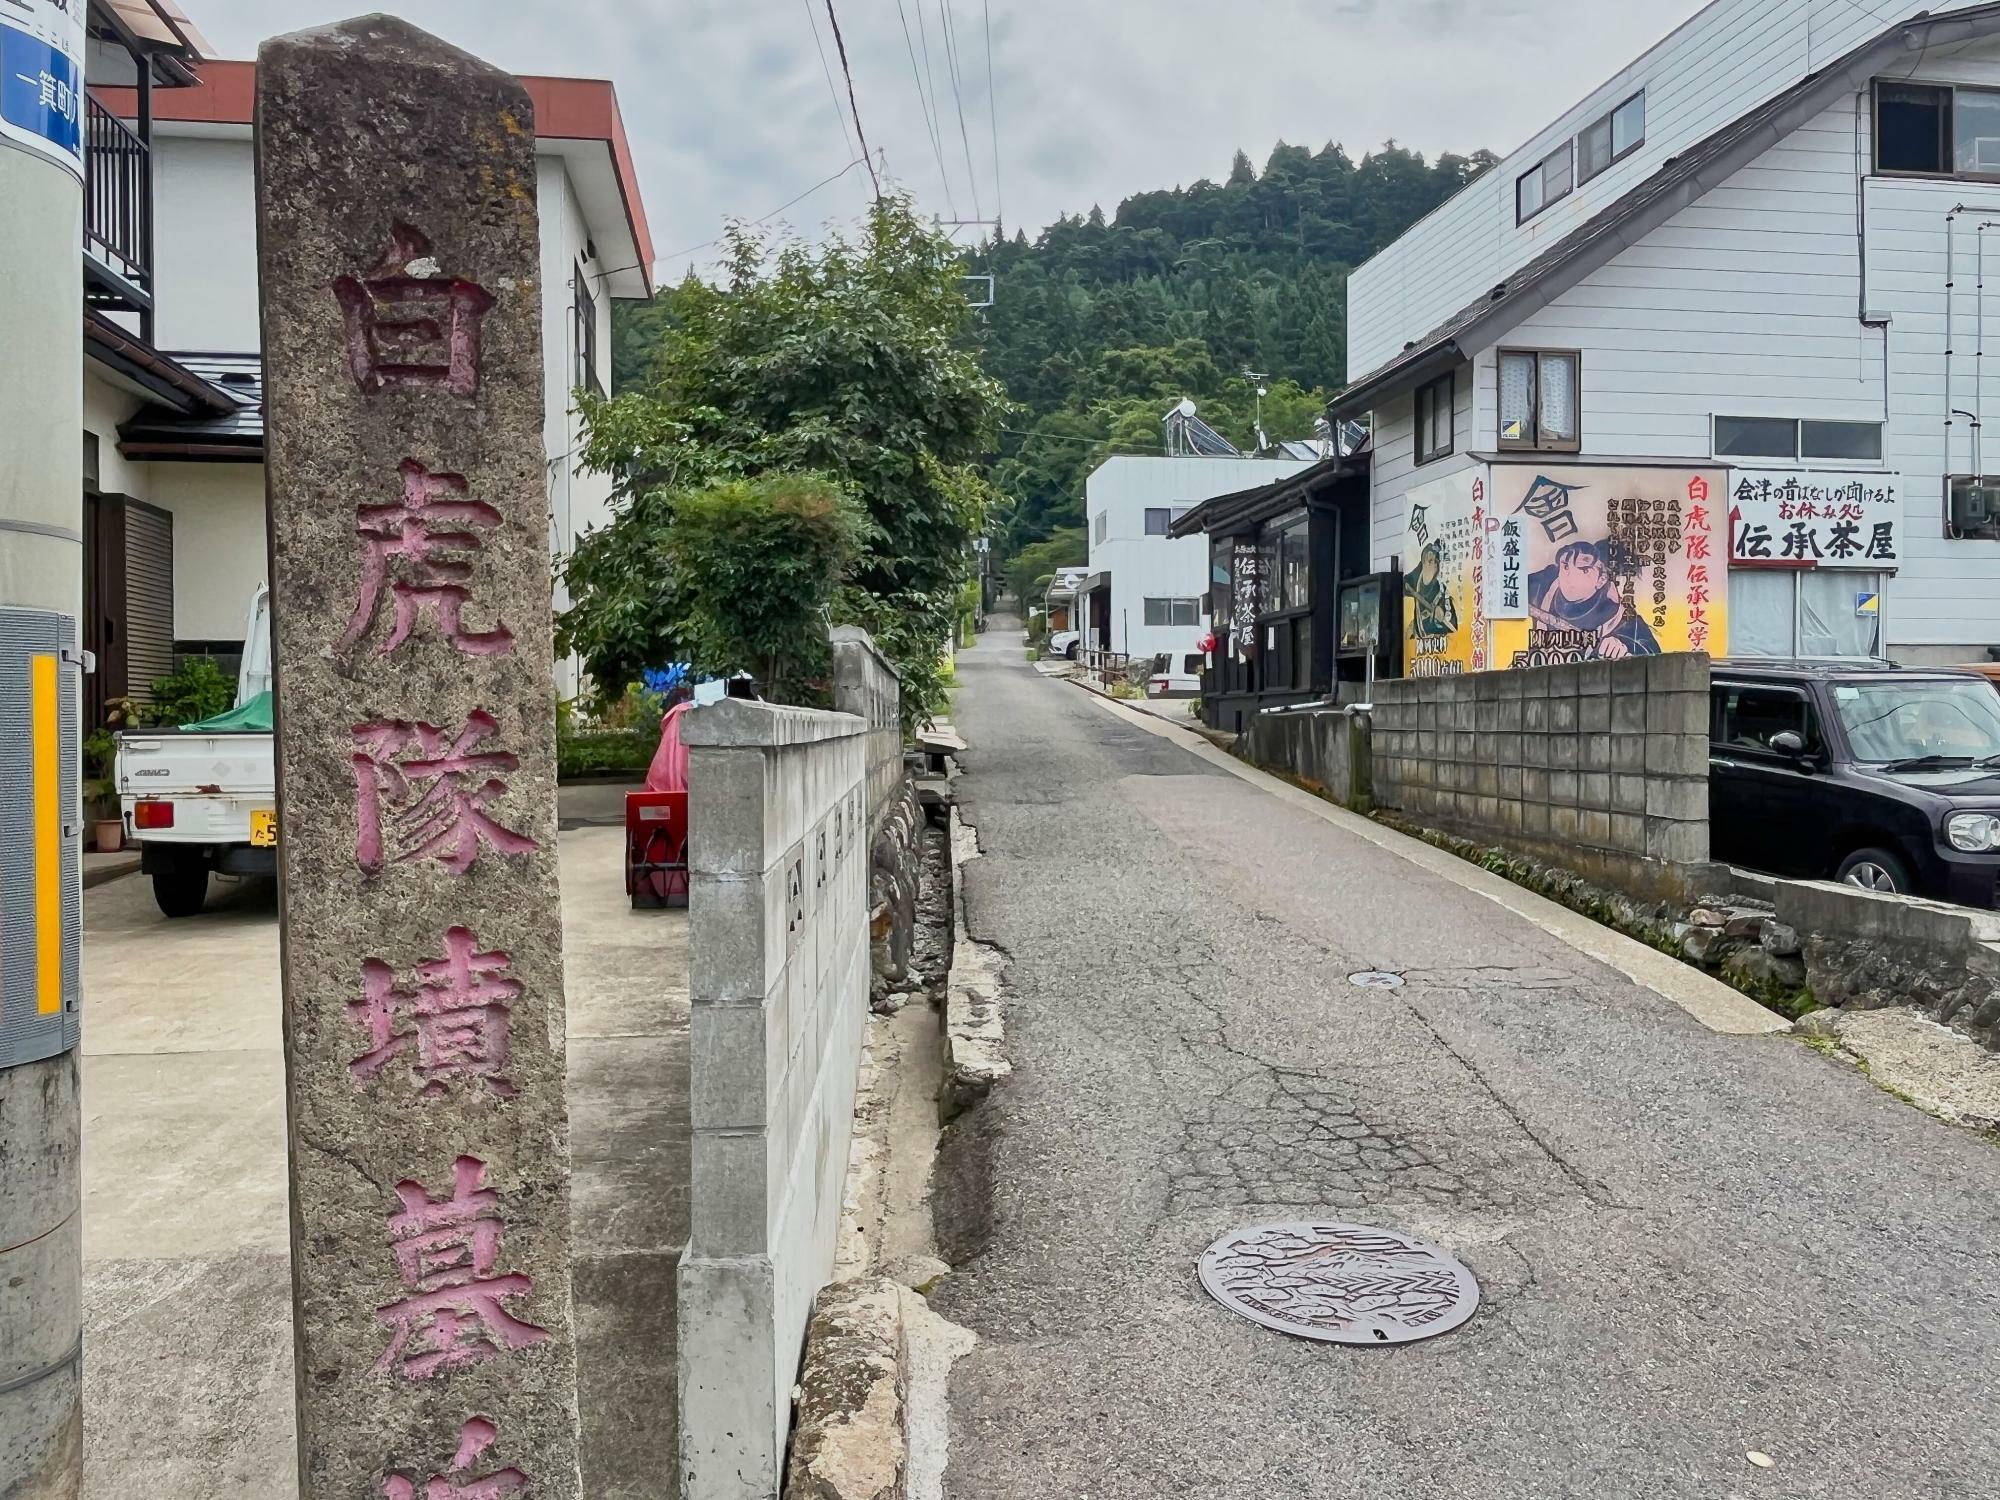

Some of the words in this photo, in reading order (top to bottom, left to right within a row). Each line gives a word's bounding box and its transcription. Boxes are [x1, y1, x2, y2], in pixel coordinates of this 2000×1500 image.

[1733, 476, 1896, 504] 会津の昔ばなしが聞けるよ
[1778, 500, 1865, 521] お休み処
[1501, 519, 1521, 609] 飯盛山近道
[1683, 475, 1712, 652] 白虎隊伝承史学
[1735, 520, 1897, 560] 伝承茶屋
[1239, 556, 1257, 646] 伝承茶屋
